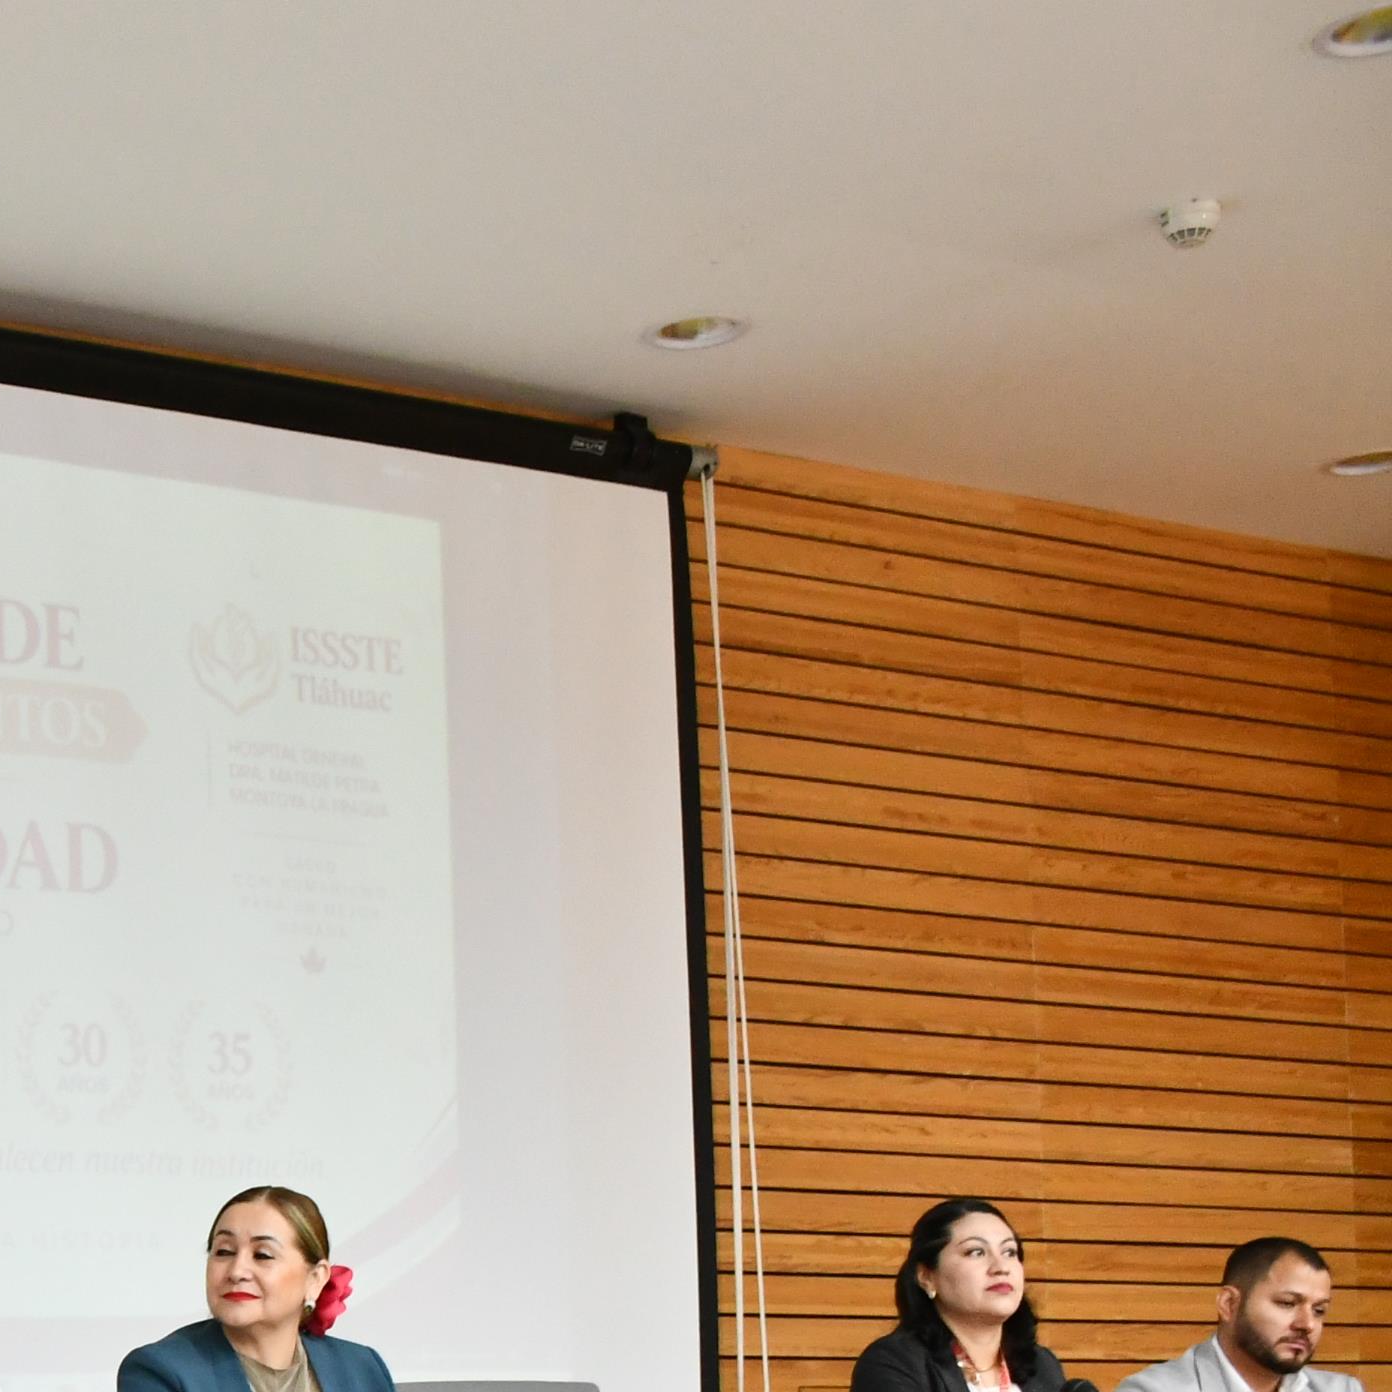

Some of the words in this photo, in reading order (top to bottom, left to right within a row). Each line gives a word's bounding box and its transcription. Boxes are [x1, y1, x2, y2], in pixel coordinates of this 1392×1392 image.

[291, 624, 403, 675] ISSSTE
[291, 673, 391, 712] Tláhuac
[57, 1021, 107, 1068] 30
[208, 1031, 252, 1077] 35
[86, 1150, 182, 1177] nuestra
